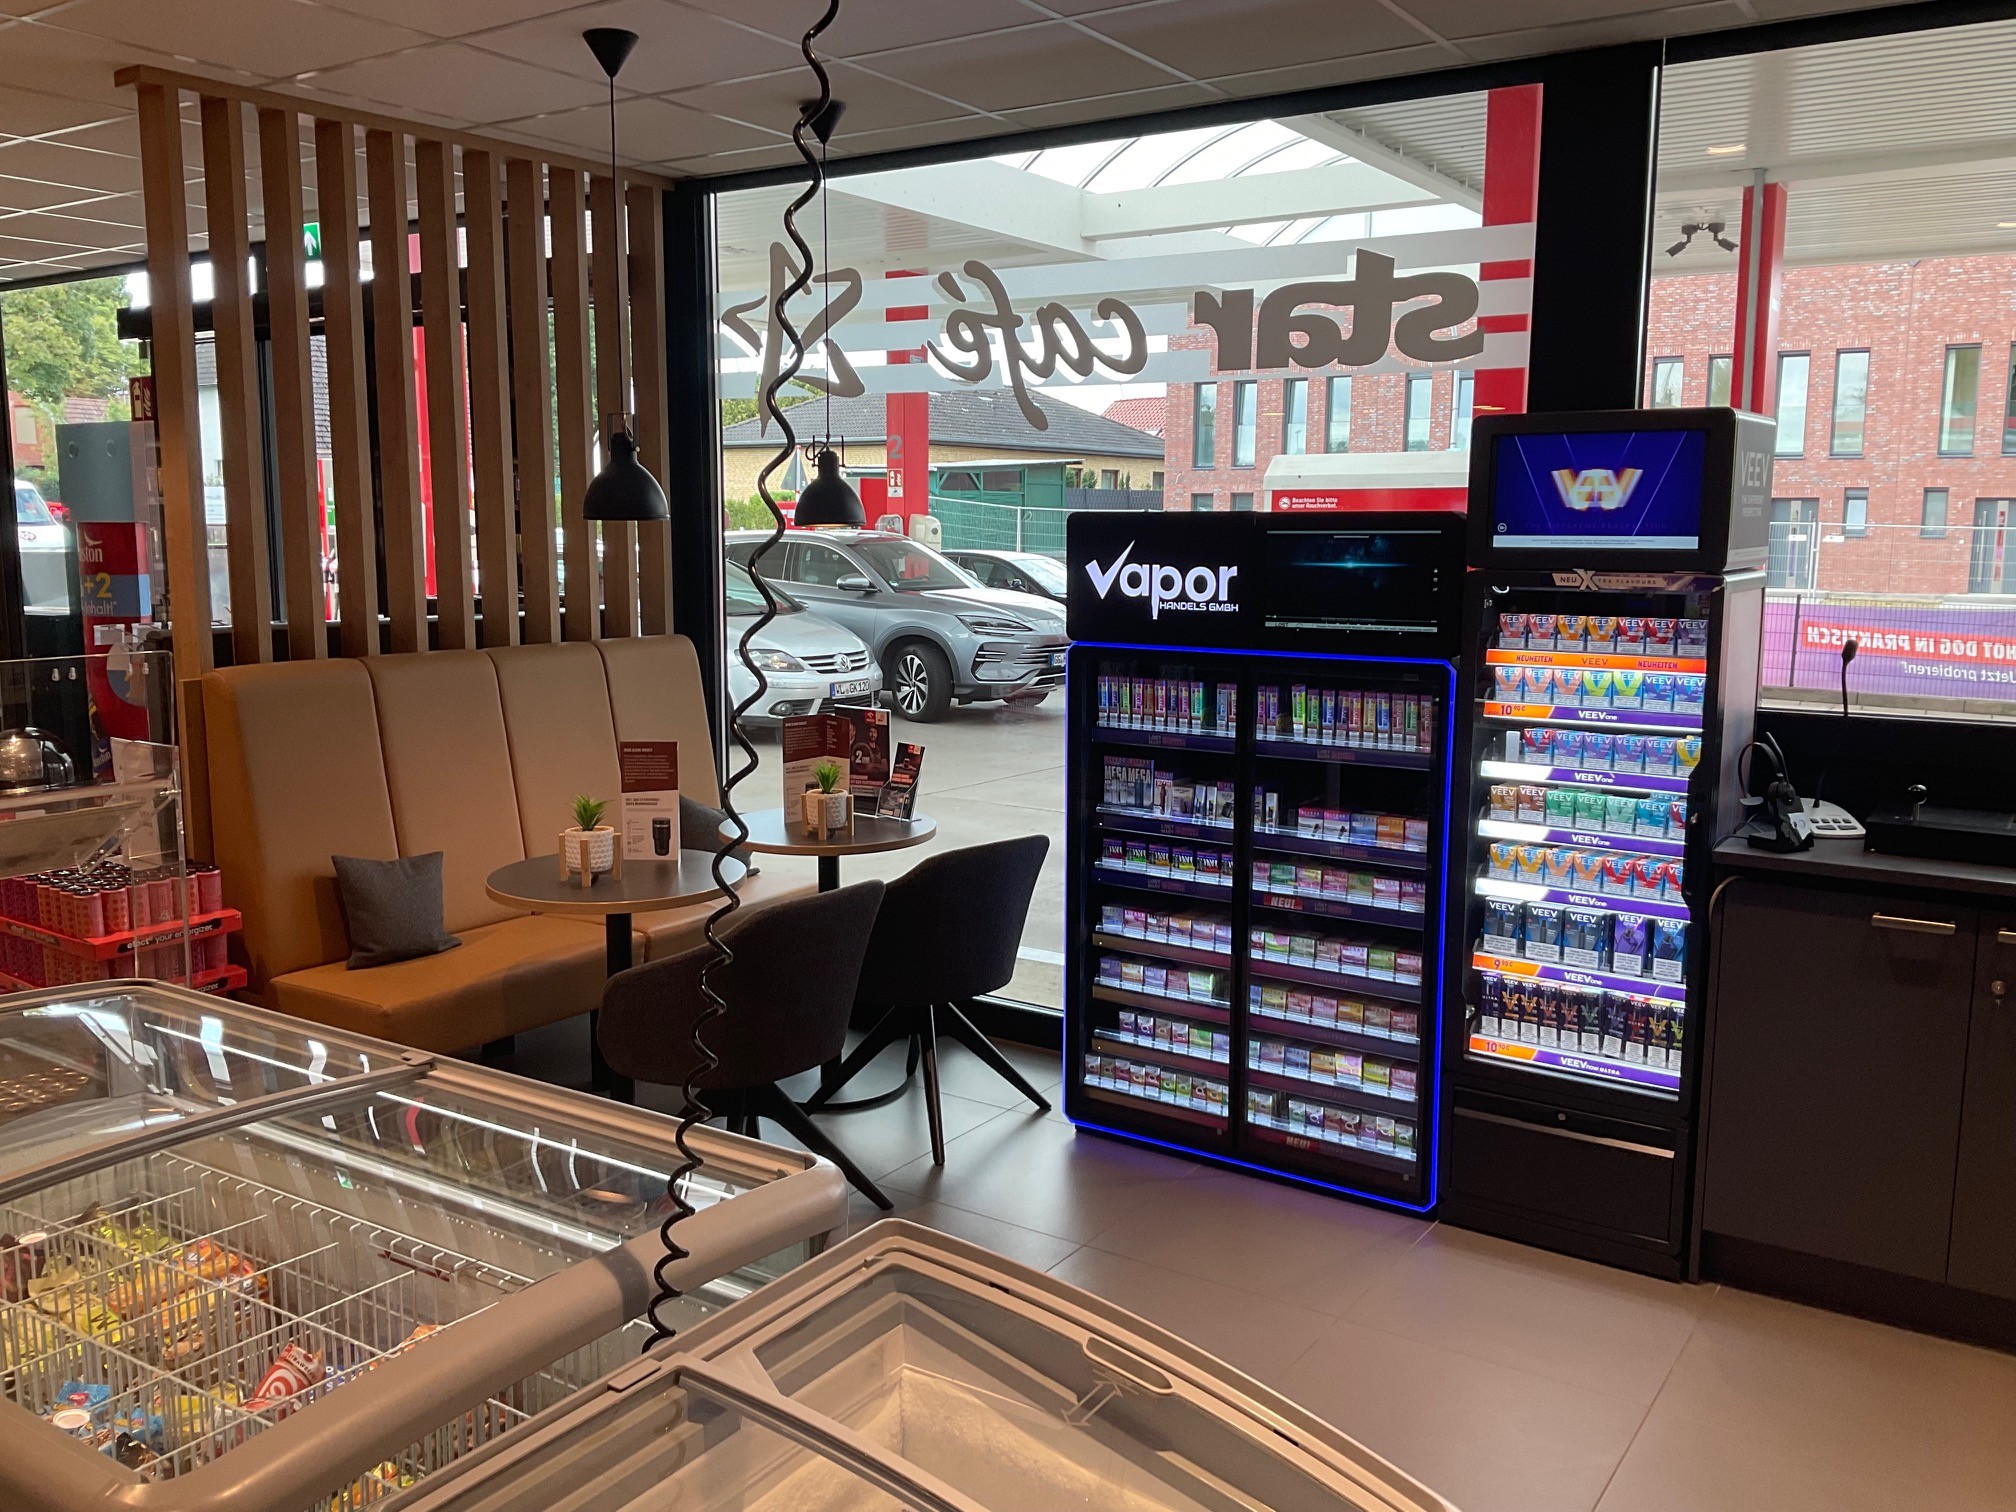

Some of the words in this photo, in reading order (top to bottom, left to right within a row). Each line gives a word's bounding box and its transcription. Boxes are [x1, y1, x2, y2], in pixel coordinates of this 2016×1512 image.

[888, 434, 903, 460] 2
[1741, 451, 1770, 488] VEEV
[1159, 601, 1207, 611] HANDELS
[1208, 602, 1239, 612] GMBH
[1500, 615, 1524, 623] VEEV
[1529, 616, 1556, 624] VEEV
[1558, 616, 1584, 625] VEEV
[1588, 617, 1616, 626] VEEV
[1618, 618, 1645, 627] VEEV
[1648, 620, 1675, 628] VEEV
[1678, 621, 1707, 629] VEEV
[1516, 655, 1553, 663] NEUHEITEN
[1581, 657, 1609, 666] VEEV
[1637, 661, 1678, 670] NEUHEITEN
[1497, 668, 1521, 676] VEEV
[1525, 669, 1552, 678] VEEV
[1555, 670, 1581, 679] VEEV
[1584, 672, 1610, 680] VEEV
[1614, 672, 1641, 681] VEEV
[1645, 676, 1673, 685] VEEV
[1676, 677, 1705, 687] VEEV
[1500, 705, 1512, 715] 10
[1524, 730, 1550, 738] VEEV
[1556, 733, 1582, 742] VEEV
[1585, 735, 1611, 744] VEEV
[1616, 737, 1643, 746] VEEV
[1647, 739, 1673, 749] VEEV
[1104, 765, 1127, 782] MEGA
[1127, 767, 1151, 784] MEGA
[1491, 787, 1515, 796] VEEV
[1519, 788, 1545, 796] VEEV
[1547, 793, 1573, 801] VEEV
[1577, 795, 1603, 804] VEEV
[1608, 798, 1634, 808] VEEV
[1639, 802, 1666, 812] VEEV
[1672, 804, 1685, 812] VE
[1491, 846, 1516, 856] VEEV
[1518, 849, 1543, 858] VEEV
[1547, 852, 1572, 863] VEEV
[1575, 857, 1601, 867] VEEV
[1605, 860, 1632, 870] VEEV
[1636, 864, 1663, 874] VEEV
[1668, 867, 1684, 876] VE
[1270, 896, 1296, 909] NEU!
[1489, 901, 1515, 912] VEEV
[1531, 907, 1558, 917] VEEV
[1570, 913, 1597, 923] VEEV
[1618, 914, 1643, 924] VEEV
[1657, 919, 1684, 929] VEEV
[155, 934, 173, 944] your
[174, 924, 213, 938] enrgizer
[1494, 960, 1500, 969] 9
[1486, 1041, 1498, 1053] 10
